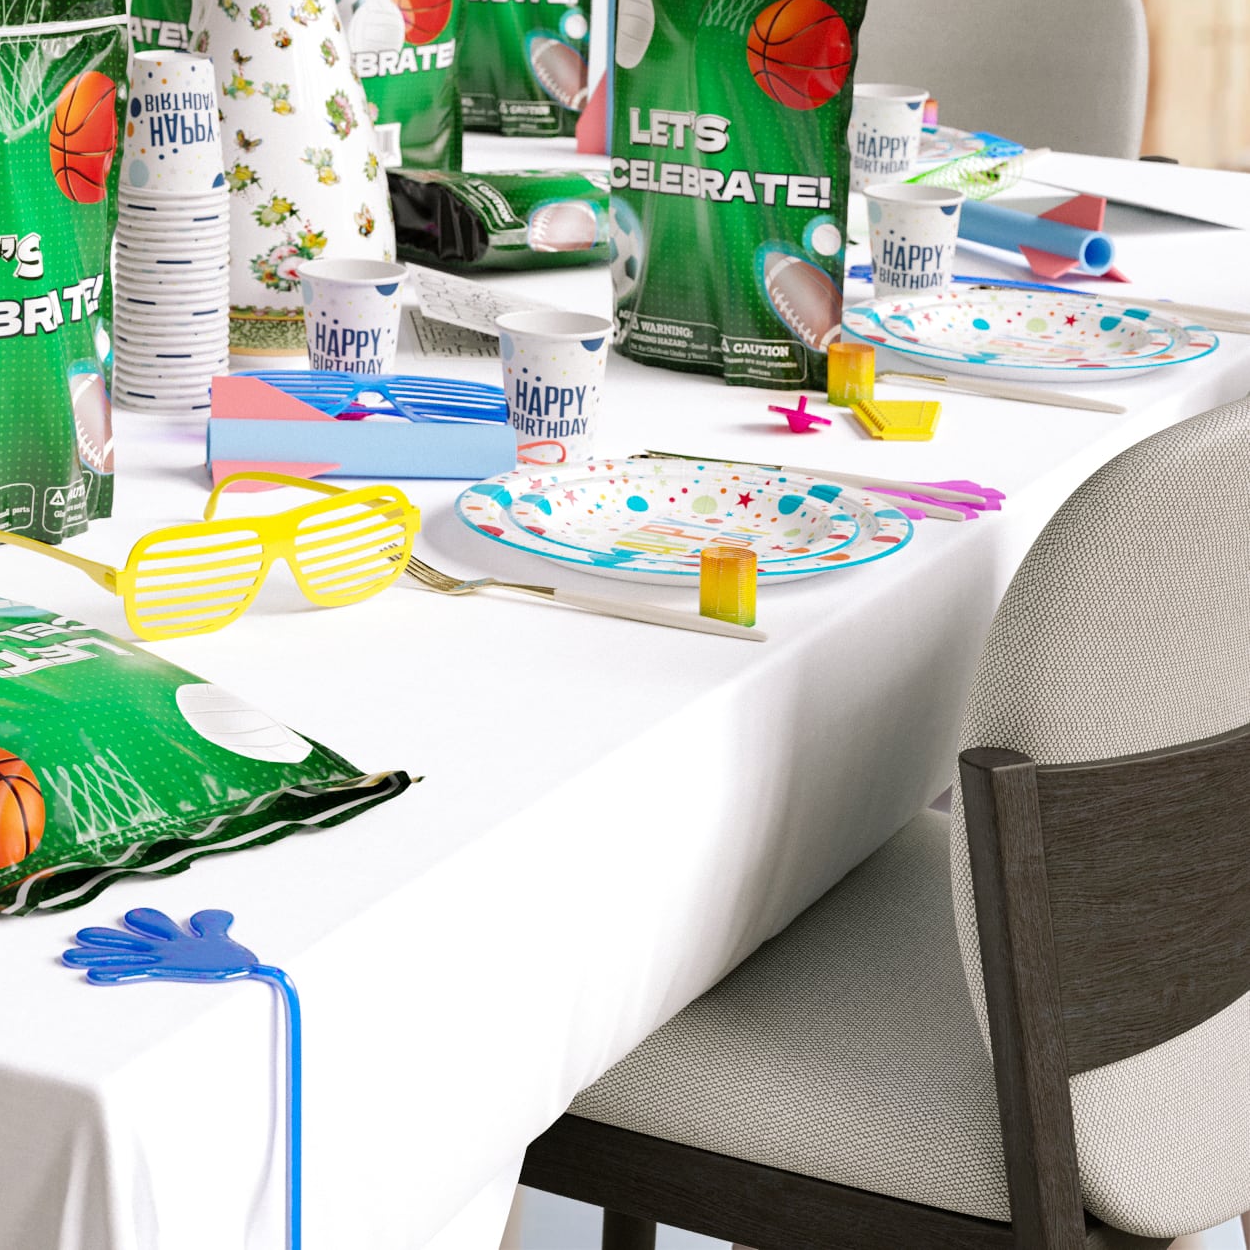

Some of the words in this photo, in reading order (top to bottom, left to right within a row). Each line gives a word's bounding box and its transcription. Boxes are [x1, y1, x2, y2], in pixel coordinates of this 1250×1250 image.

[630, 107, 731, 153] LET'S
[856, 131, 910, 158] HAPPY
[854, 156, 910, 174] BIRTHDAY
[611, 157, 831, 210] CELEBRATE!
[883, 239, 944, 272] HAPPY
[879, 266, 944, 290] BIRTHDAY
[314, 321, 383, 359] HAPPY
[733, 343, 790, 358] CAUTION
[313, 351, 384, 376] BIRTHDAY
[515, 377, 588, 418] HAPPY
[512, 410, 589, 438] BIRTHDAY
